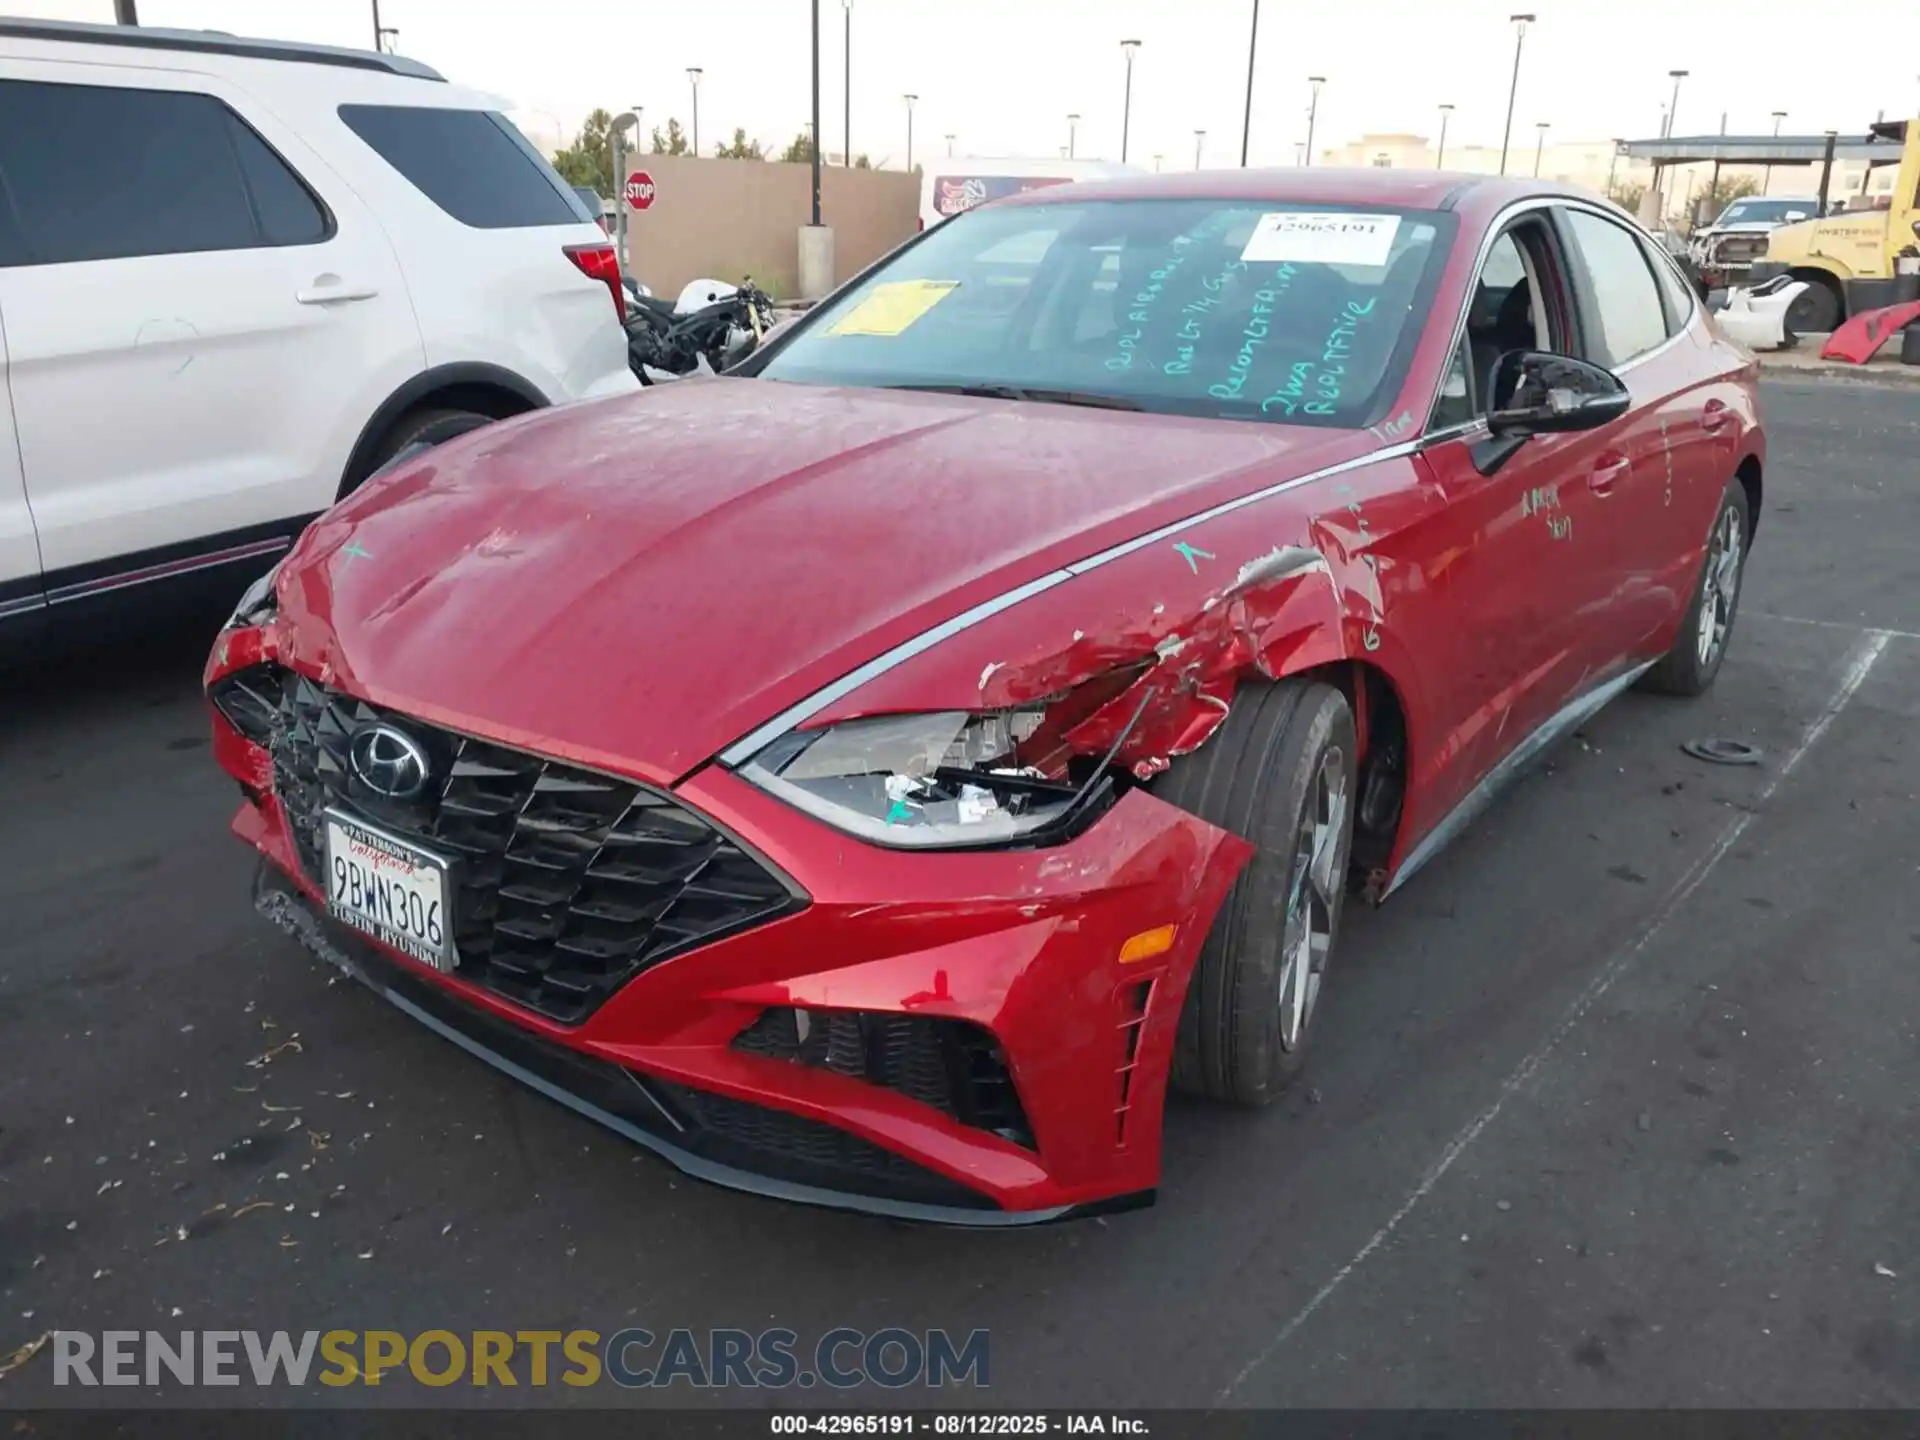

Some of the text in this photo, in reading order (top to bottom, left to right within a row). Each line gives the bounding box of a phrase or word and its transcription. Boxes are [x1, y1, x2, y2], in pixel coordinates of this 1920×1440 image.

[627, 182, 654, 200] STOP
[335, 855, 443, 946] 9BWN306
[380, 927, 440, 969] HYUNDAI
